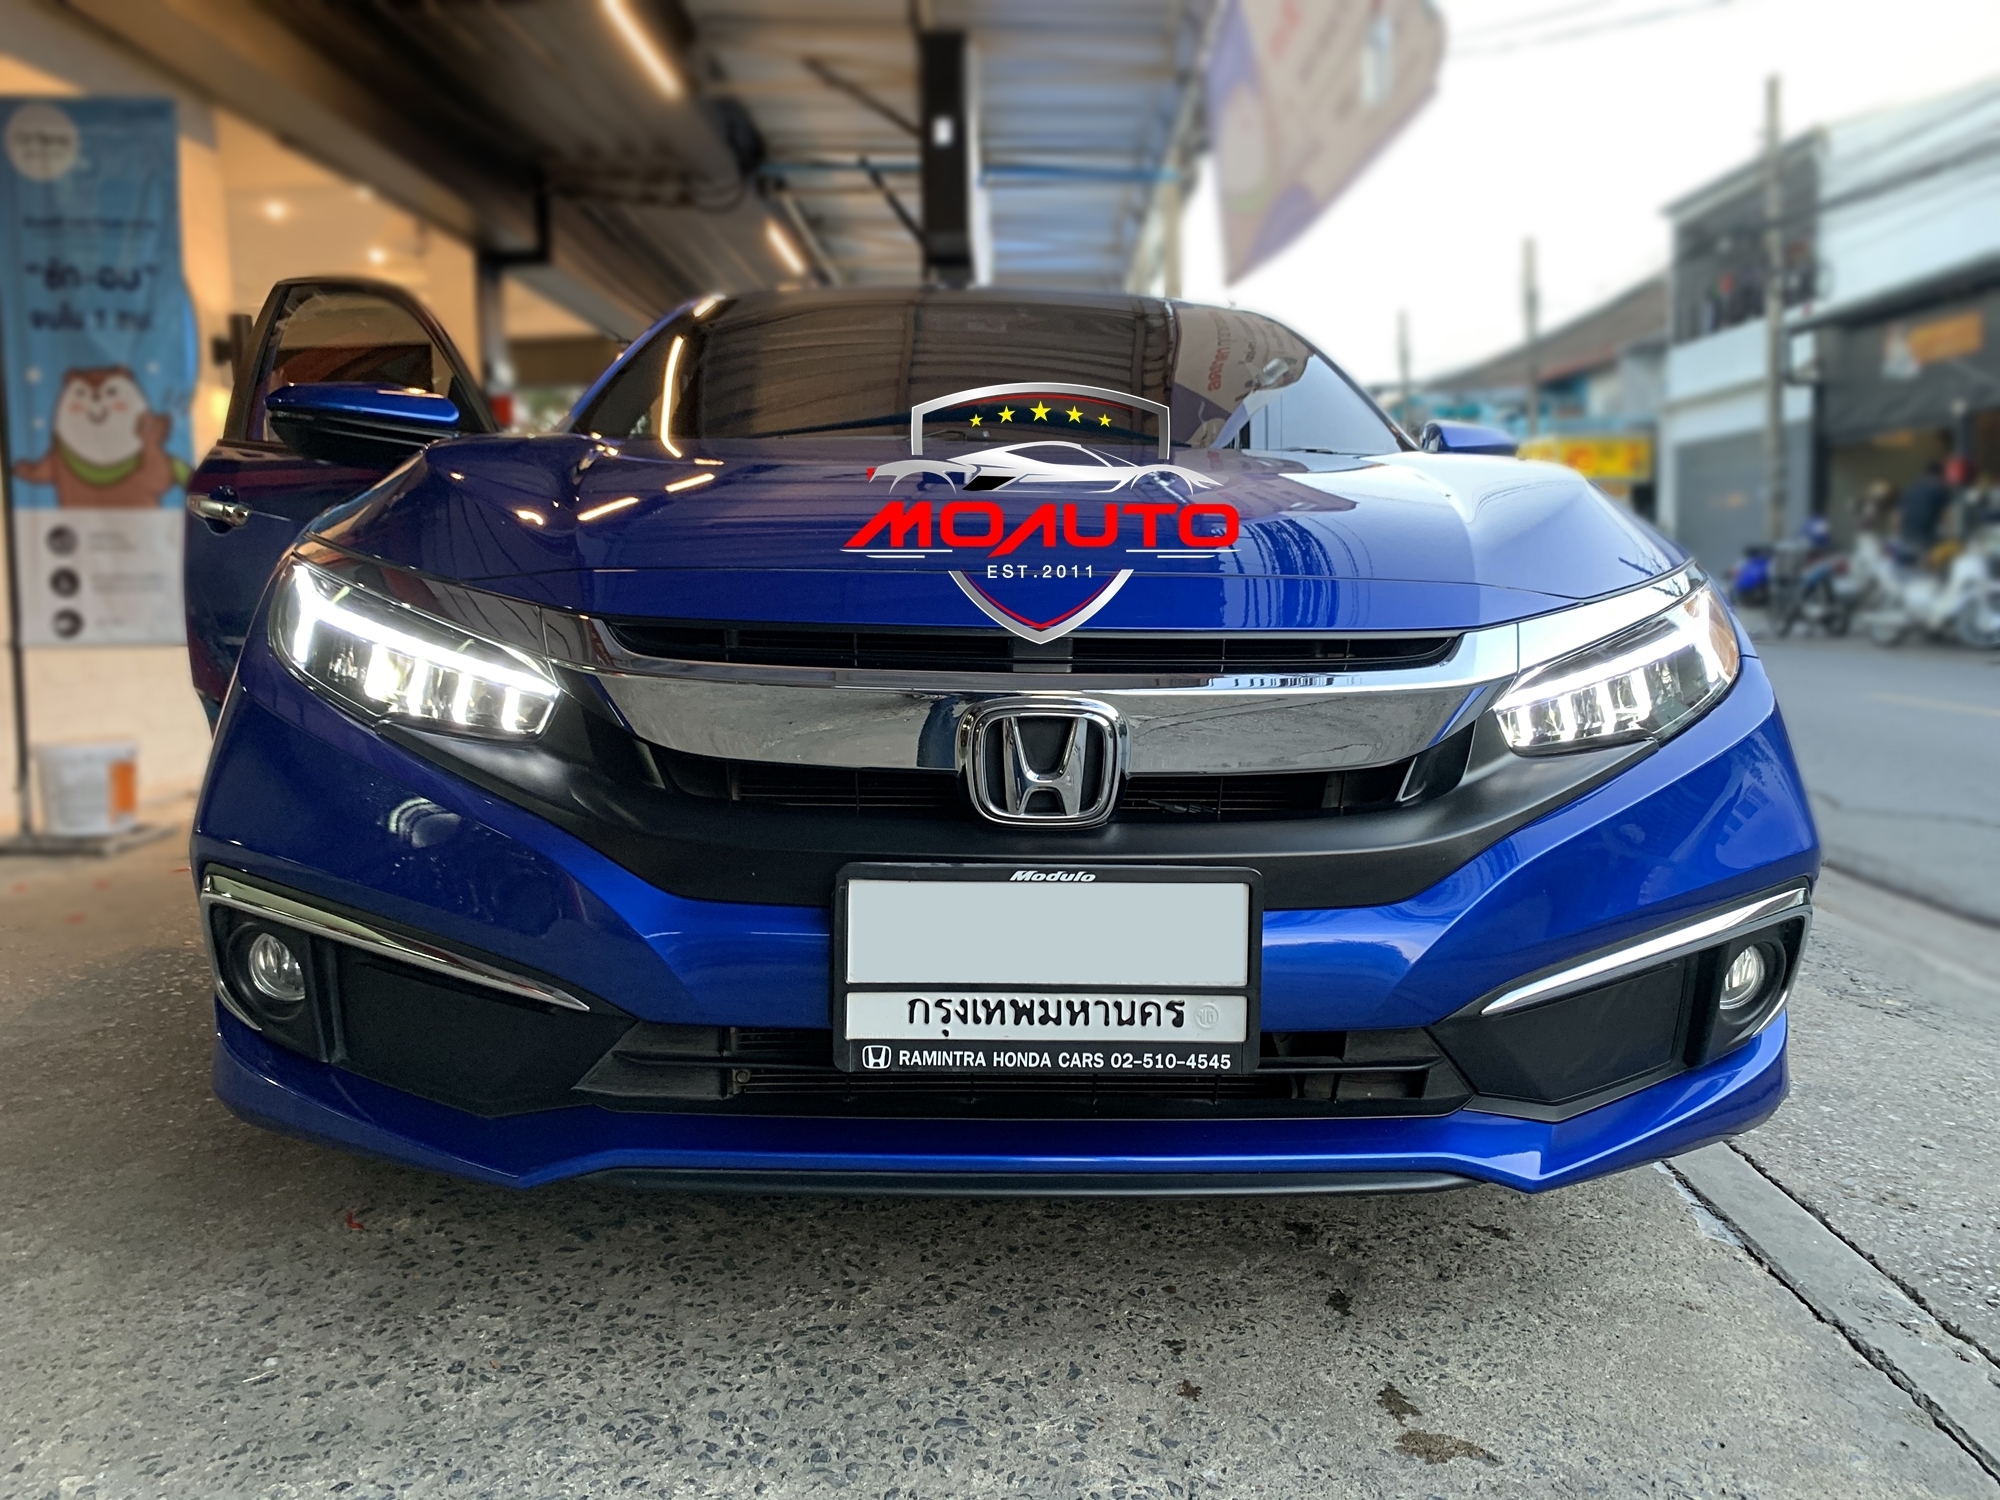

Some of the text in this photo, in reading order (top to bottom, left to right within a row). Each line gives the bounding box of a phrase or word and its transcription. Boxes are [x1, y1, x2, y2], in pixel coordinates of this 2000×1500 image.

[1009, 870, 1097, 883] Modulo
[907, 997, 1185, 1037] กรุงเทพมหานคร
[899, 1049, 987, 1068] RAMINTRA
[993, 1051, 1052, 1069] HONDA
[1058, 1052, 1105, 1069] CARS
[1110, 1052, 1231, 1070] 02-510-4545
